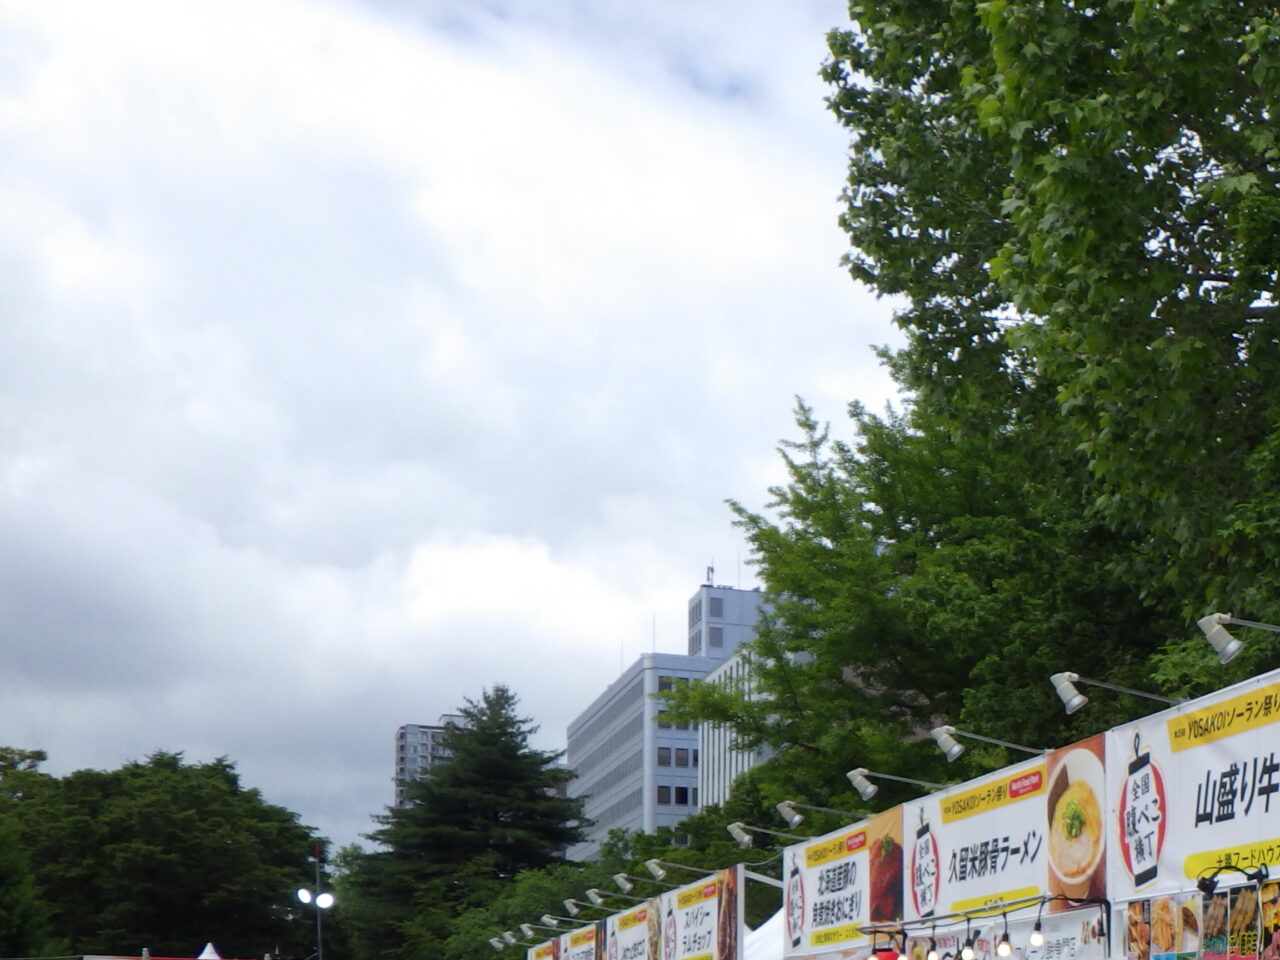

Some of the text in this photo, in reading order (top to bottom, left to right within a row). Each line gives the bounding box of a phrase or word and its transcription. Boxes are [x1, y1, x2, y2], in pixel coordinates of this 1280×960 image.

[1132, 773, 1150, 801] 全国
[1126, 799, 1160, 838] 腹ぺこ
[948, 829, 1042, 884] 久留米豚骨ラーメン
[683, 926, 713, 955] ラムチョップ
